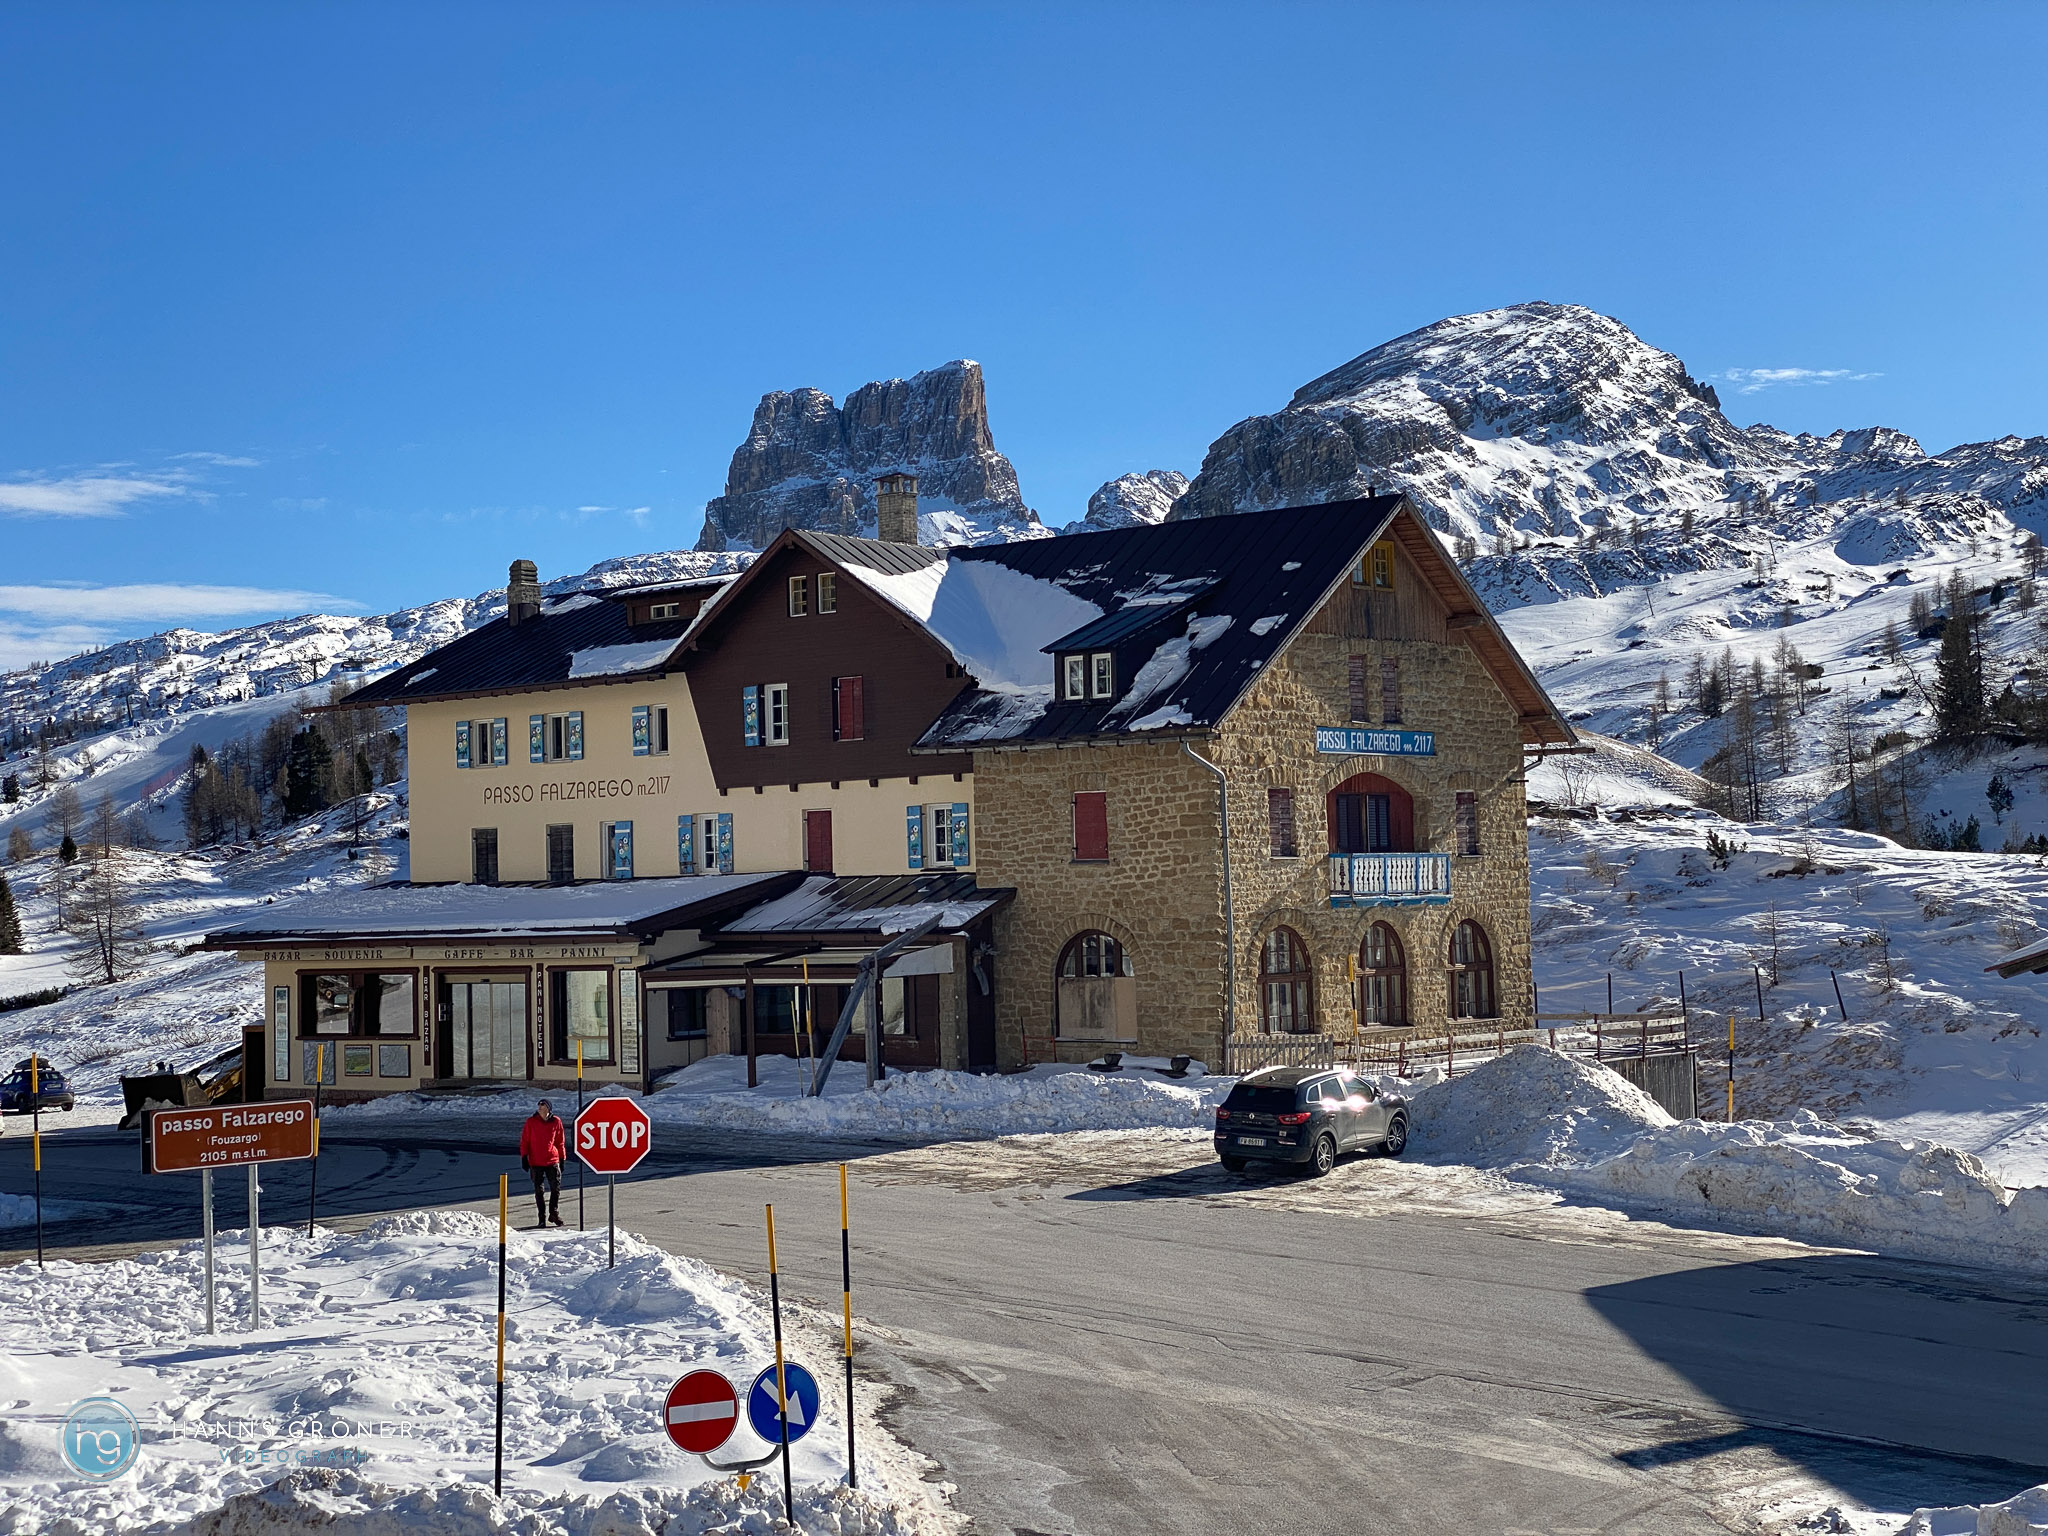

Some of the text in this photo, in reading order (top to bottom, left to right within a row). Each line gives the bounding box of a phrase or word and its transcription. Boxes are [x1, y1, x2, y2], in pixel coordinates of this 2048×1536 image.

[1316, 730, 1346, 749] PASSO
[1350, 732, 1400, 751] FALZAREGO
[483, 784, 534, 805] PASSO
[541, 778, 633, 802] FALZAREGO
[264, 951, 301, 960] BAZAR
[324, 950, 383, 960] SOUVENIR
[509, 948, 534, 958] BAR
[561, 947, 606, 957] PANINI
[162, 1109, 305, 1135] passo Falzarego
[206, 1132, 262, 1146] (Fouzargo)
[580, 1121, 646, 1150] STOP
[200, 1150, 227, 1162] 2105
